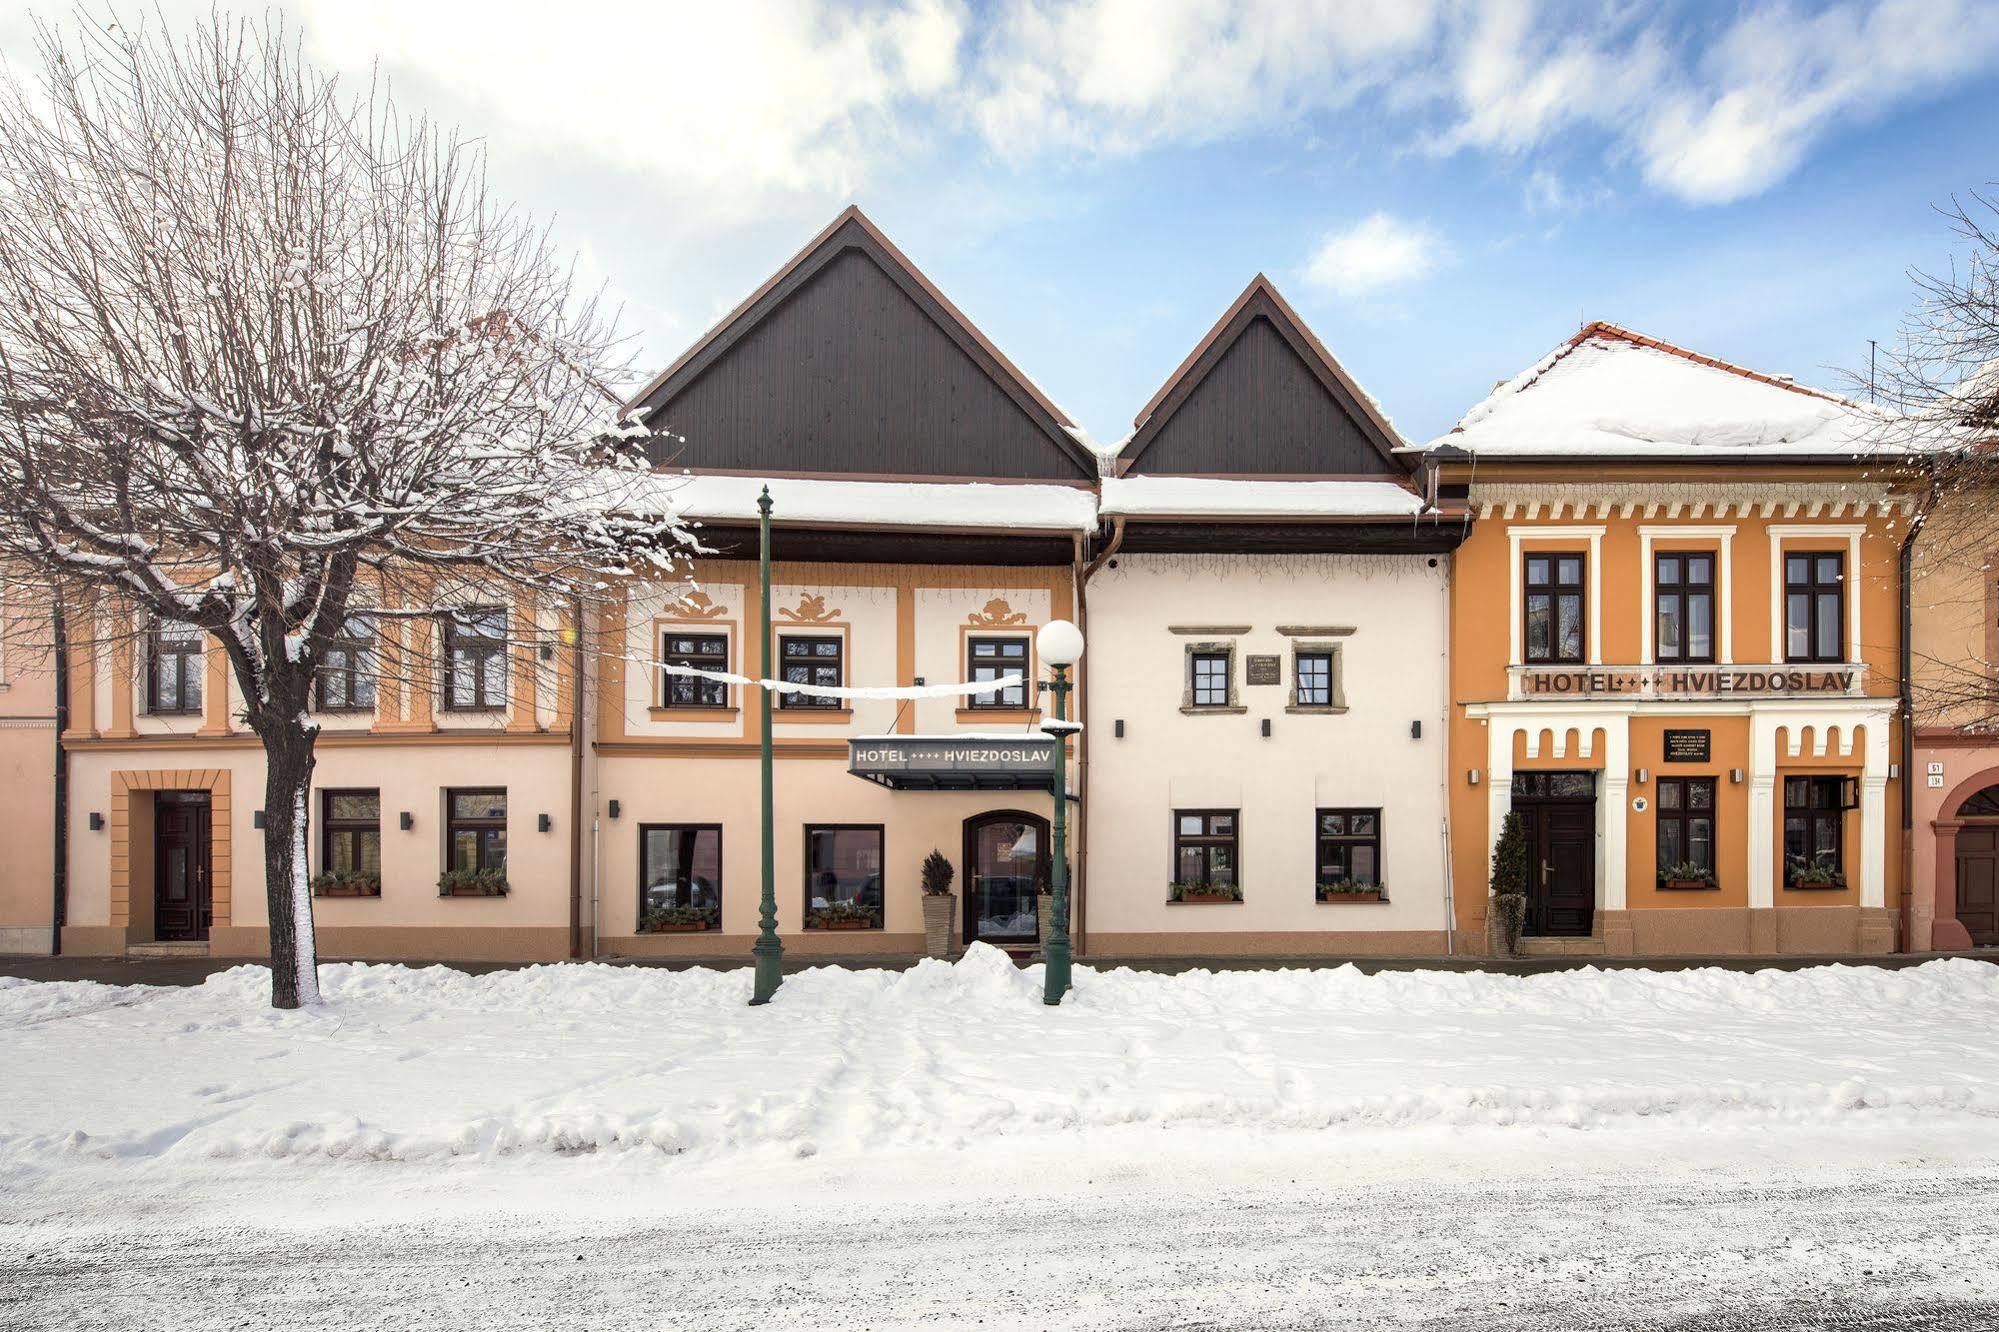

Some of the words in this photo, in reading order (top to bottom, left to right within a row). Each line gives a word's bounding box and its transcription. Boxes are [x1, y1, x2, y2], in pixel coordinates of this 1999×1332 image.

[1534, 673, 1622, 693] HOTEL
[1672, 671, 1855, 692] HVIEZDOSLAV
[856, 750, 908, 762] HOTEL
[944, 750, 1050, 762] HVIEZDOSLAV
